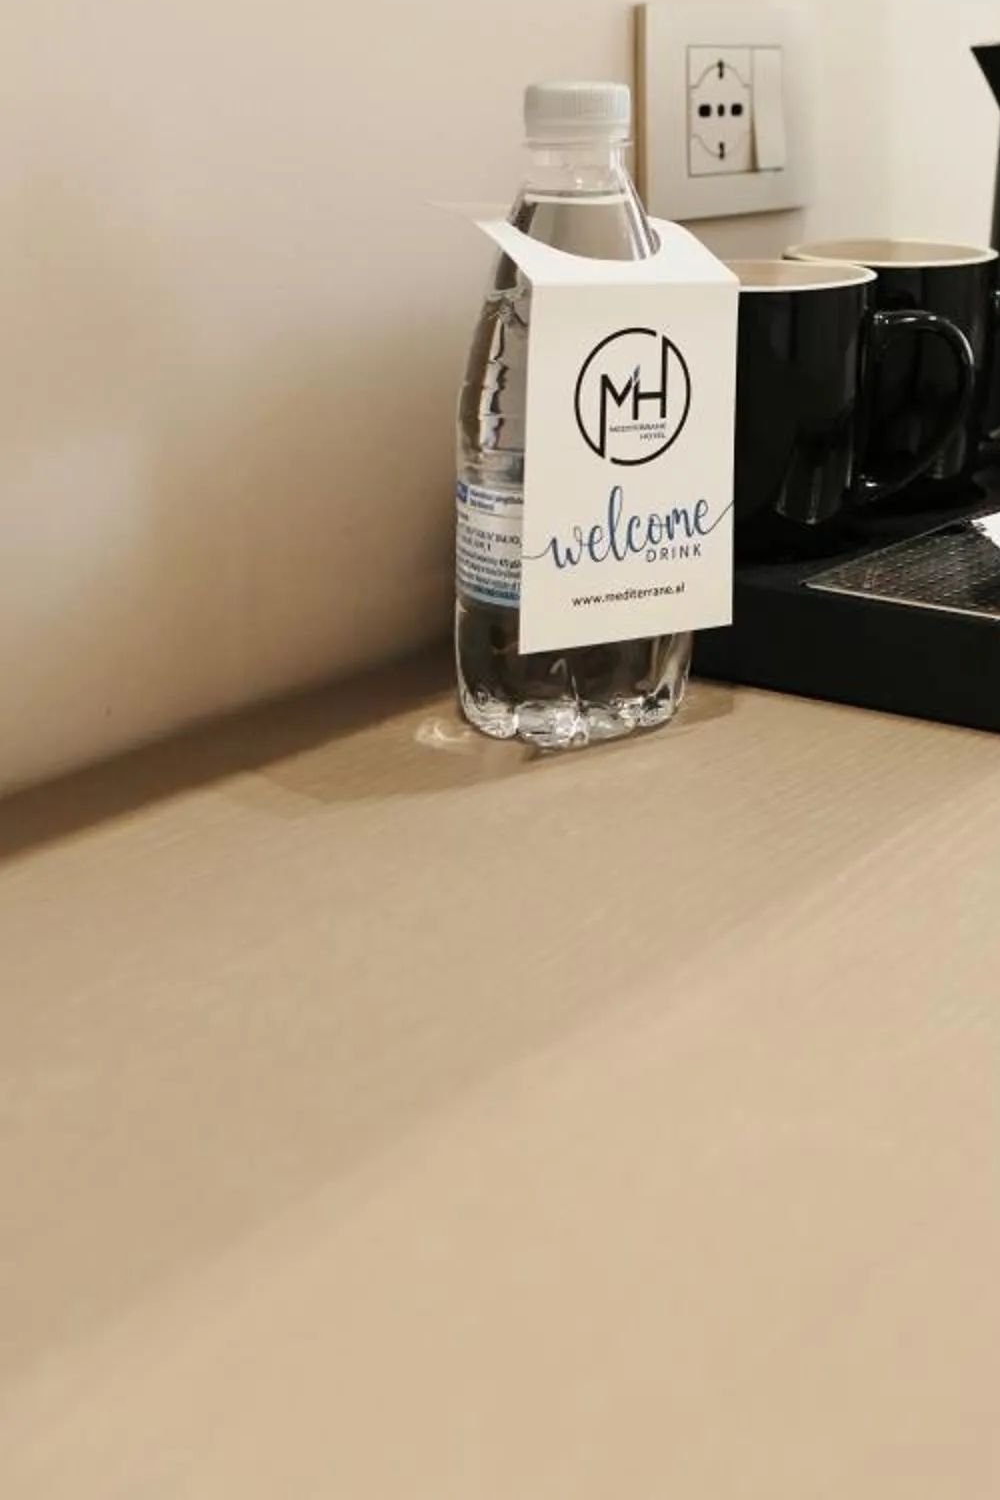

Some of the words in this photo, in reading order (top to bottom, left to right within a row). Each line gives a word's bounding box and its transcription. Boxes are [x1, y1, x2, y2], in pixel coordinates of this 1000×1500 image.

[521, 485, 734, 569] welcome
[646, 543, 702, 563] DRINK
[571, 582, 685, 607] www.mediterrane.al
